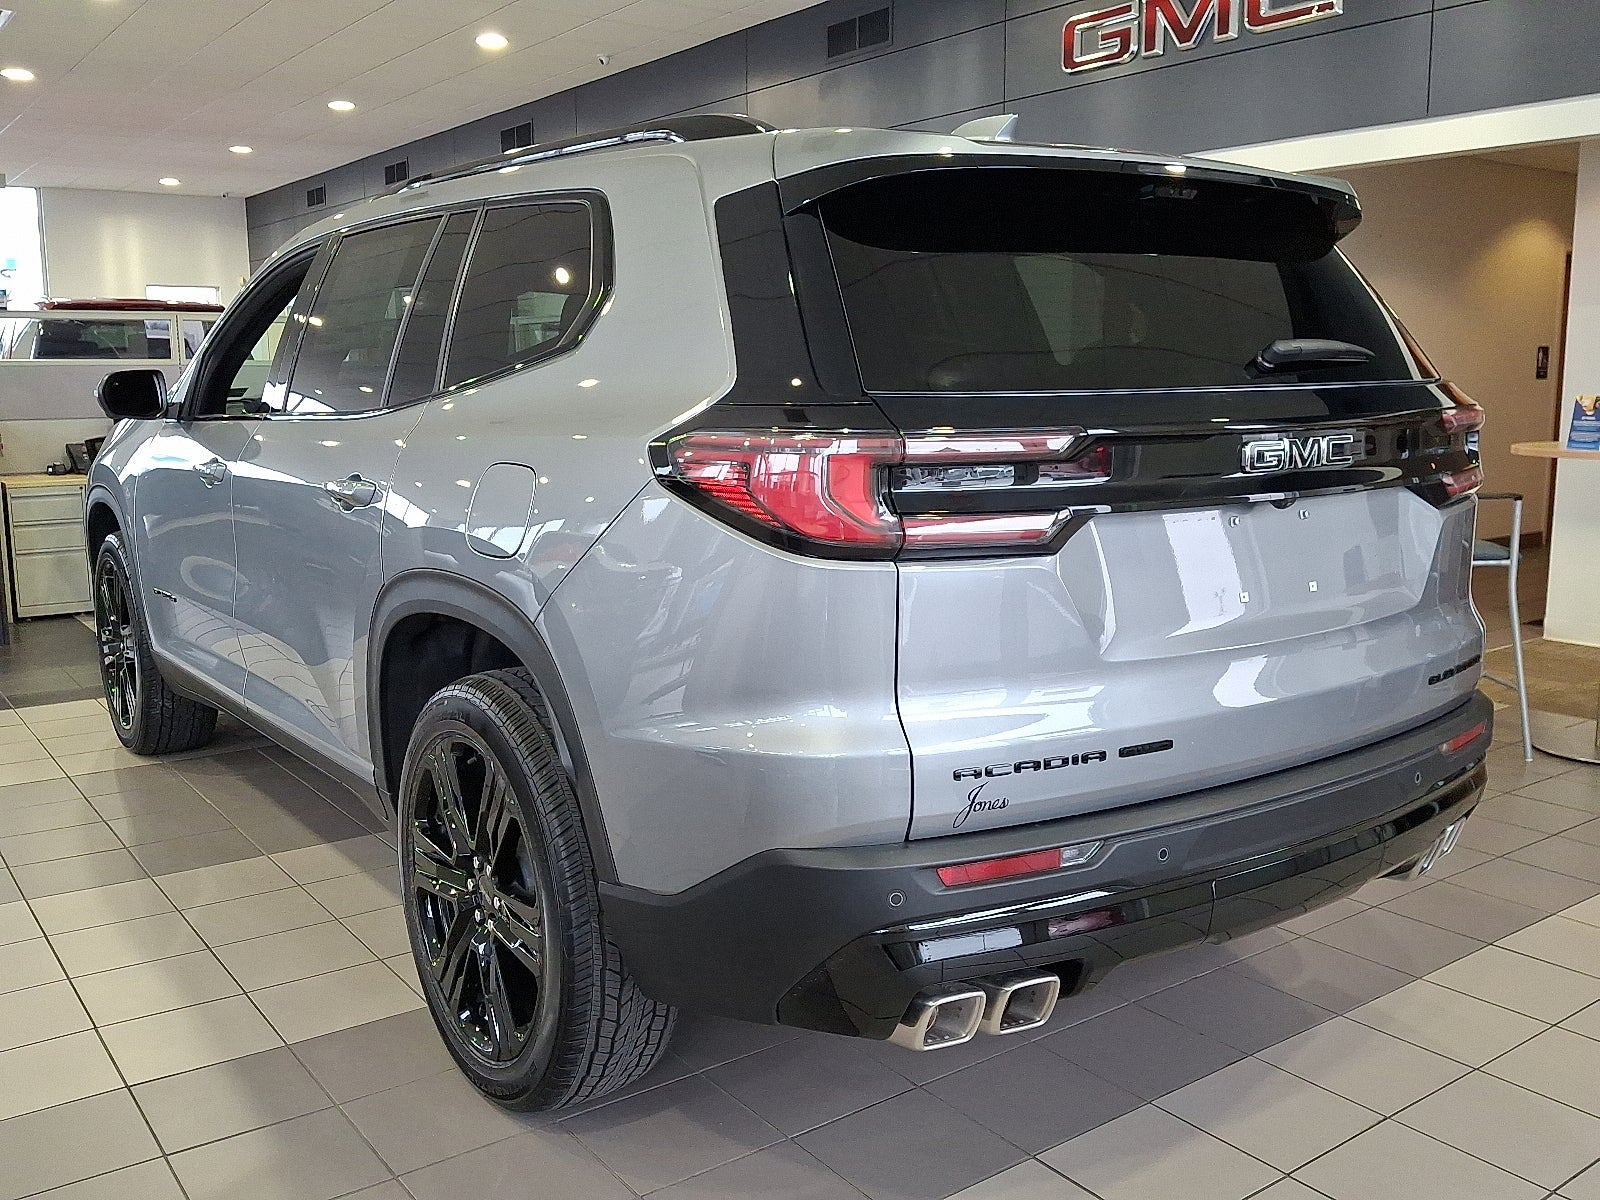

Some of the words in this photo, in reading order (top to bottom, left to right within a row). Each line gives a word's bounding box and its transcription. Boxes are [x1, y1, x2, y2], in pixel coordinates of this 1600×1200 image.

[1242, 434, 1353, 473] GMC
[952, 750, 1107, 782] ACADIA
[952, 781, 1010, 829] Jones
